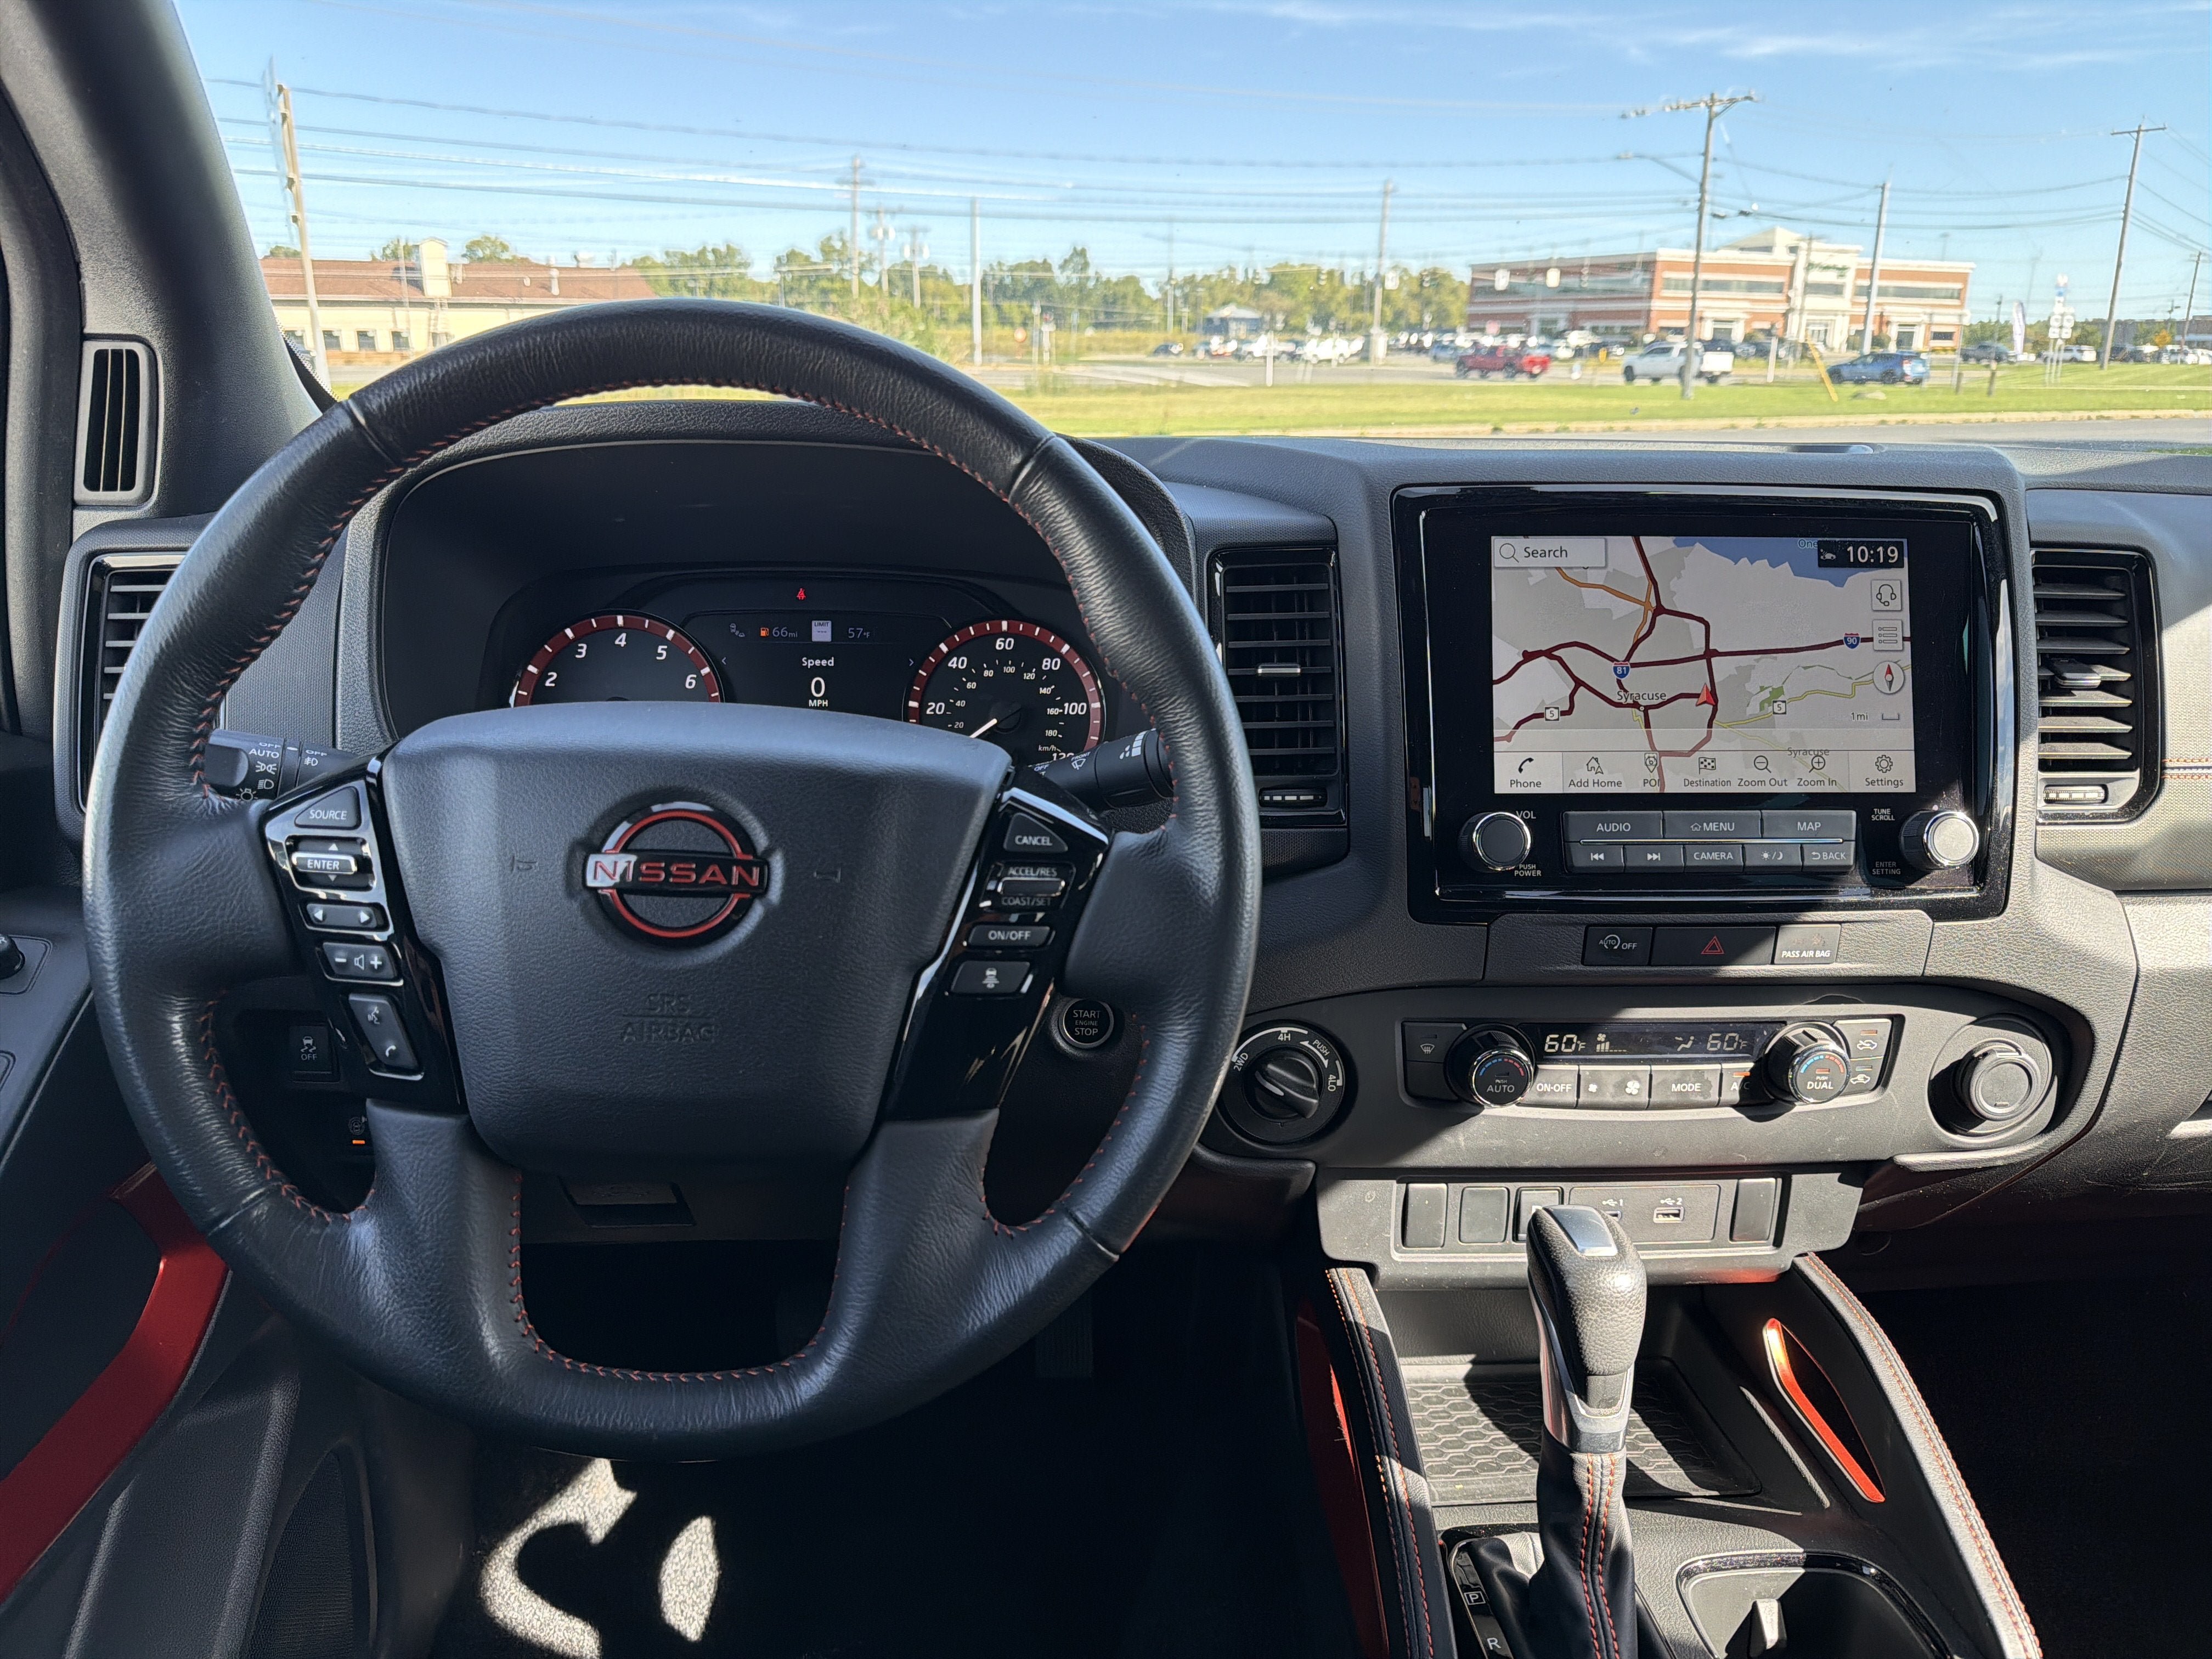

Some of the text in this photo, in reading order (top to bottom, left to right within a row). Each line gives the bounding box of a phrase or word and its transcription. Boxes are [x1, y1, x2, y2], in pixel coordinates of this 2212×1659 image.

[1524, 546, 1568, 558] Search
[1847, 546, 1898, 563] 10:19
[615, 633, 627, 647] 4
[995, 637, 1014, 651] 60
[575, 644, 587, 658] 3
[656, 645, 668, 660] 5
[802, 657, 834, 668] Speed
[947, 657, 967, 670] 40
[1042, 658, 1060, 671] 80
[1003, 665, 1015, 674] 100
[545, 672, 557, 687] 2
[1023, 672, 1036, 680] 120
[685, 674, 697, 689] 6
[811, 677, 825, 697] 0
[1039, 687, 1052, 695] 140
[1617, 690, 1667, 701] Syracuse
[926, 702, 945, 715] 20
[955, 699, 966, 708] 40
[1063, 702, 1087, 715] 100
[1046, 707, 1059, 715] 160
[954, 721, 964, 729] 20
[249, 748, 280, 759] AUTO
[1787, 748, 1830, 758] Syracuse
[1510, 779, 1542, 788] Phone
[1568, 778, 1622, 788] Add Home
[1643, 778, 1660, 787] POI
[1684, 778, 1731, 787] Destination
[1737, 778, 1788, 787] Zoom Out
[1797, 778, 1837, 787] Zoom In
[1865, 777, 1904, 788] Settings
[309, 809, 347, 820] SOURCE
[1516, 810, 1536, 819] VOL
[1596, 823, 1631, 832] AUDIO
[1703, 822, 1735, 831] MENU
[1797, 822, 1821, 831] MAP
[1015, 835, 1052, 846] CANCEL
[1694, 852, 1733, 860] CAMERA
[1822, 852, 1847, 860] BACK
[307, 859, 340, 870] ENTER
[594, 860, 760, 886] NISSAN
[1008, 867, 1057, 876] ACCEL/RES
[1001, 896, 1051, 906] COAST/SET
[988, 930, 1031, 940] ON/OFF
[1073, 1010, 1101, 1018] START
[1075, 1028, 1098, 1036] STOP
[1312, 1039, 1330, 1057] PUSH
[1233, 1052, 1248, 1071] 2WD
[1328, 1074, 1336, 1092] 4LO
[1672, 1083, 1702, 1092] MODE
[1730, 1081, 1750, 1091] A/C
[1807, 1081, 1833, 1090] DUAL
[1486, 1085, 1515, 1093] AUTO
[1487, 1638, 1501, 1650] R
